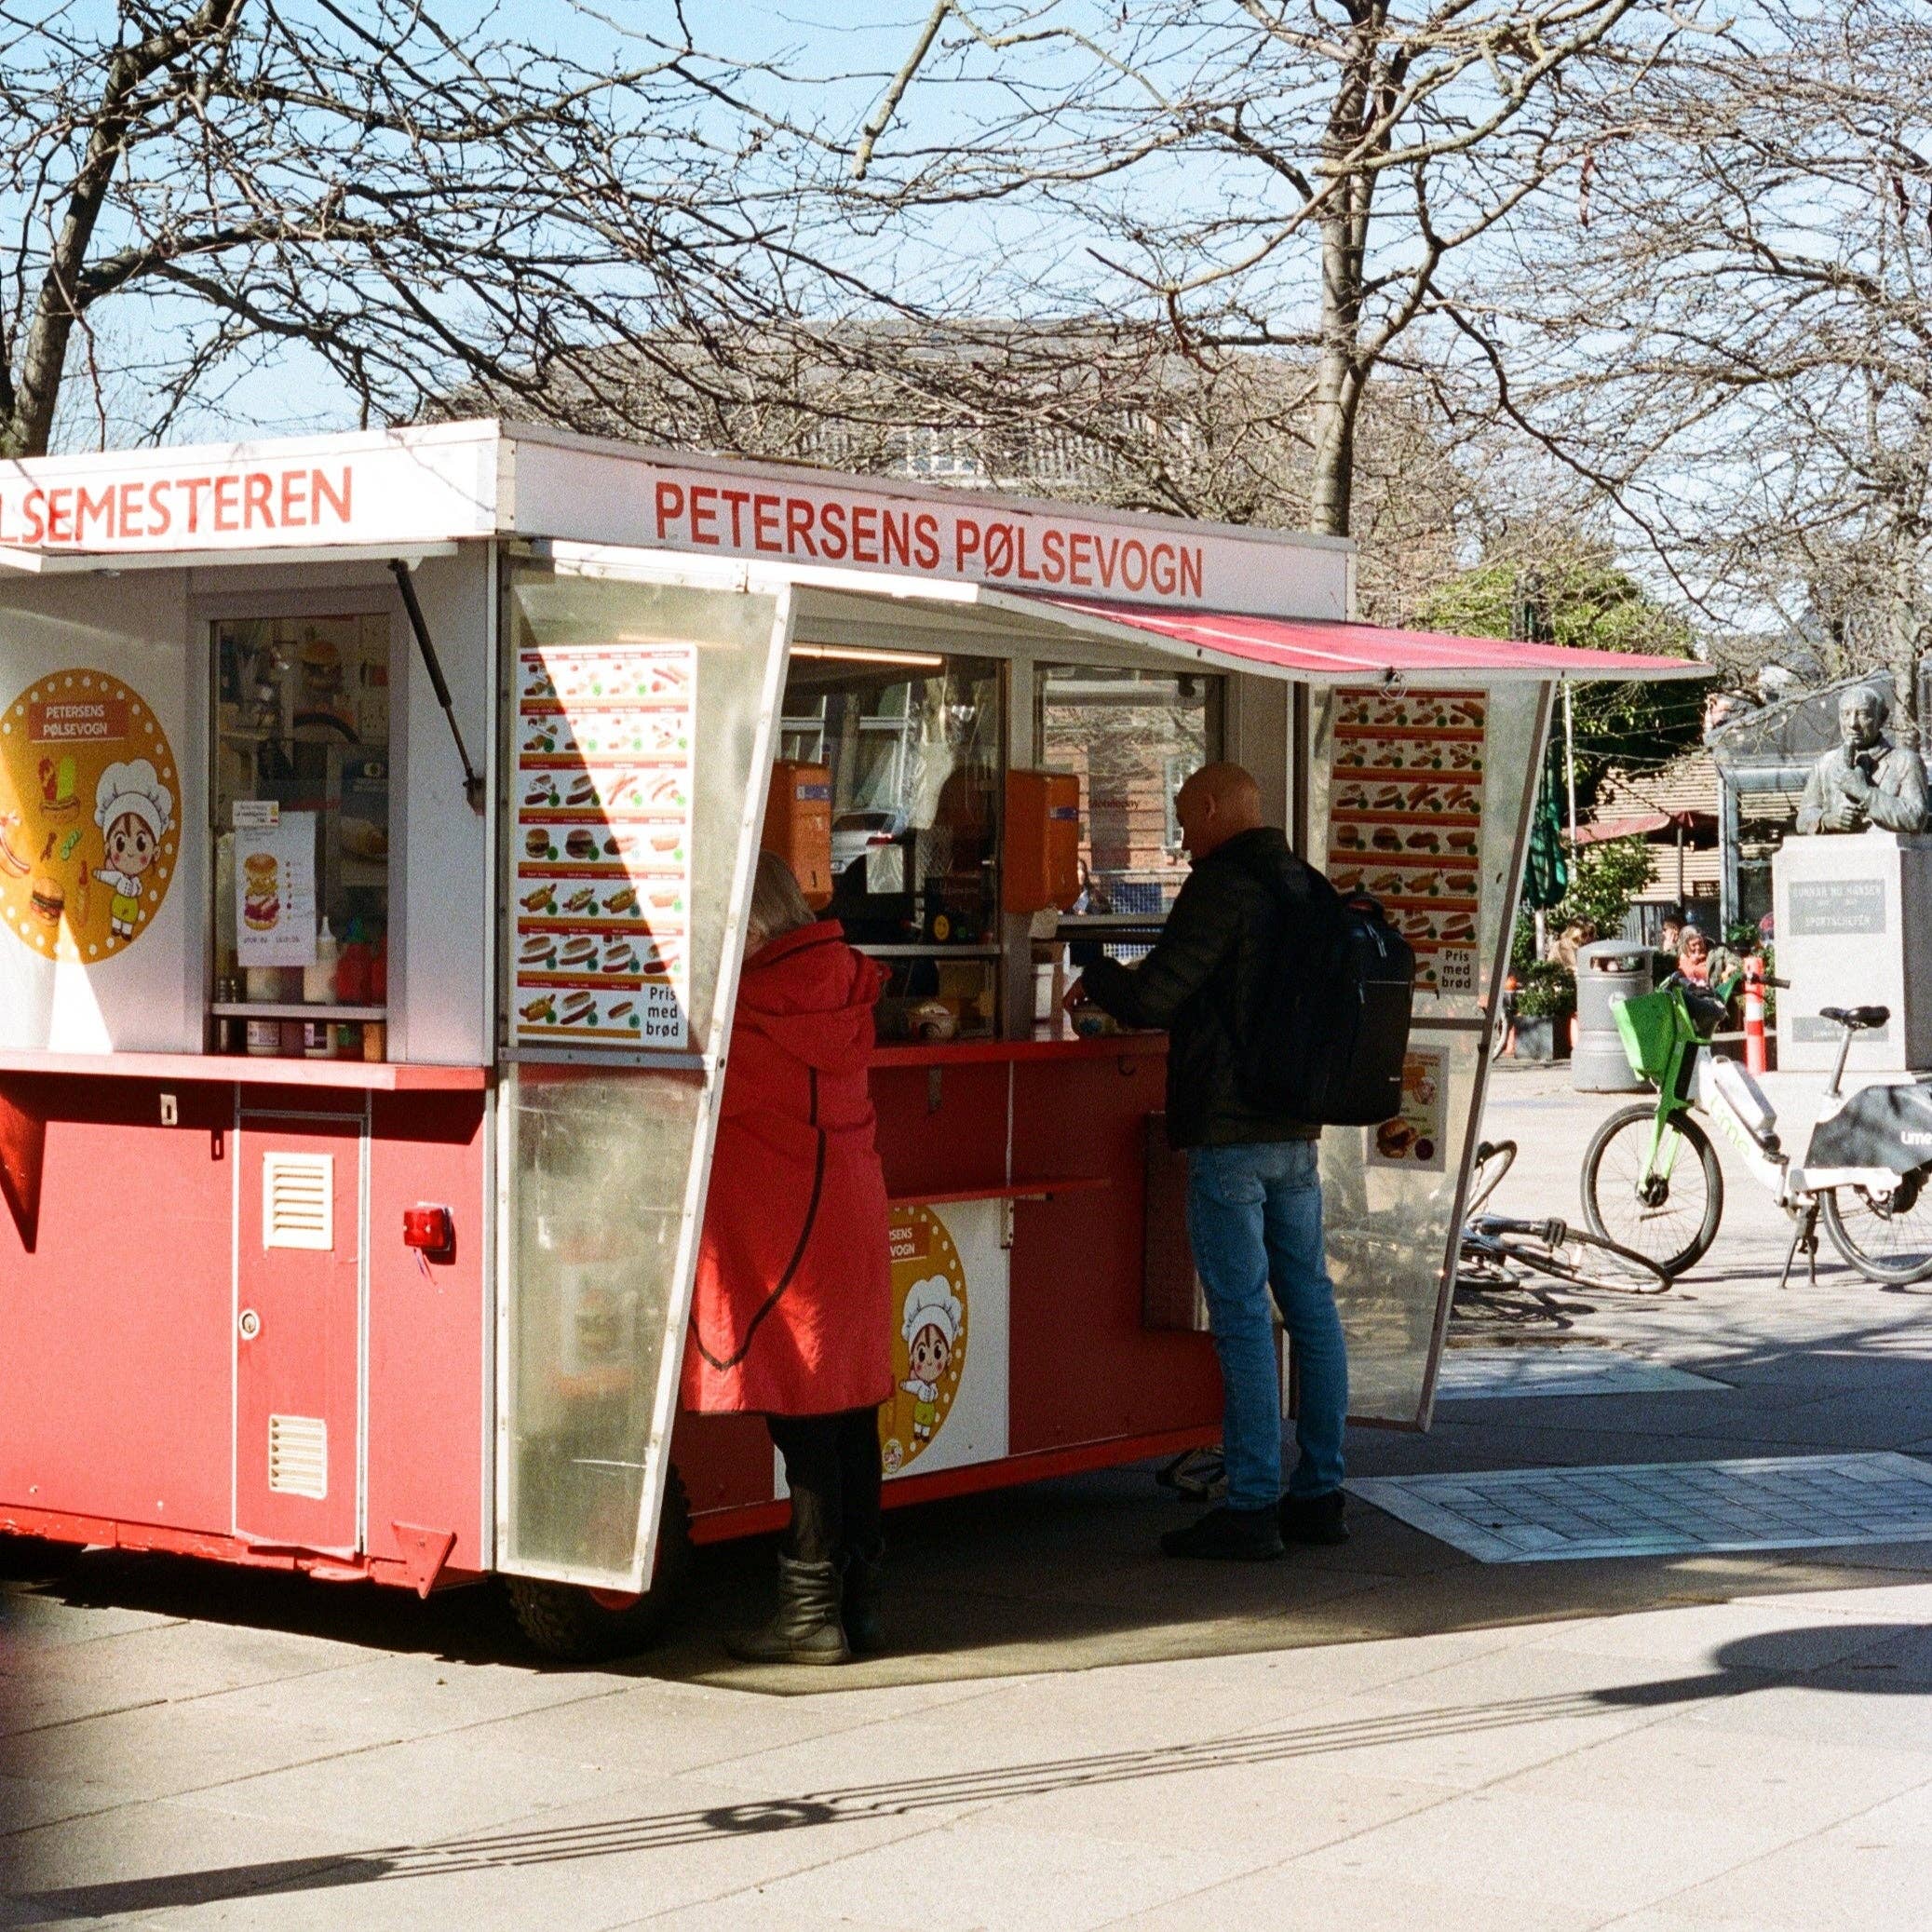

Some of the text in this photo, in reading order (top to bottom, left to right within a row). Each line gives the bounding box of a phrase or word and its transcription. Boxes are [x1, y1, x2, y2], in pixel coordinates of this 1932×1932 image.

[655, 481, 1202, 598] PETERSENS PØLSEVOGN
[46, 705, 105, 719] PETERSENS
[43, 723, 108, 736] PØLSEVOGN
[1445, 950, 1469, 962] Pris
[1443, 964, 1470, 975] med
[1441, 976, 1471, 989] brød
[649, 986, 676, 1001] Pris
[647, 1005, 678, 1019] med
[646, 1021, 679, 1037] brød
